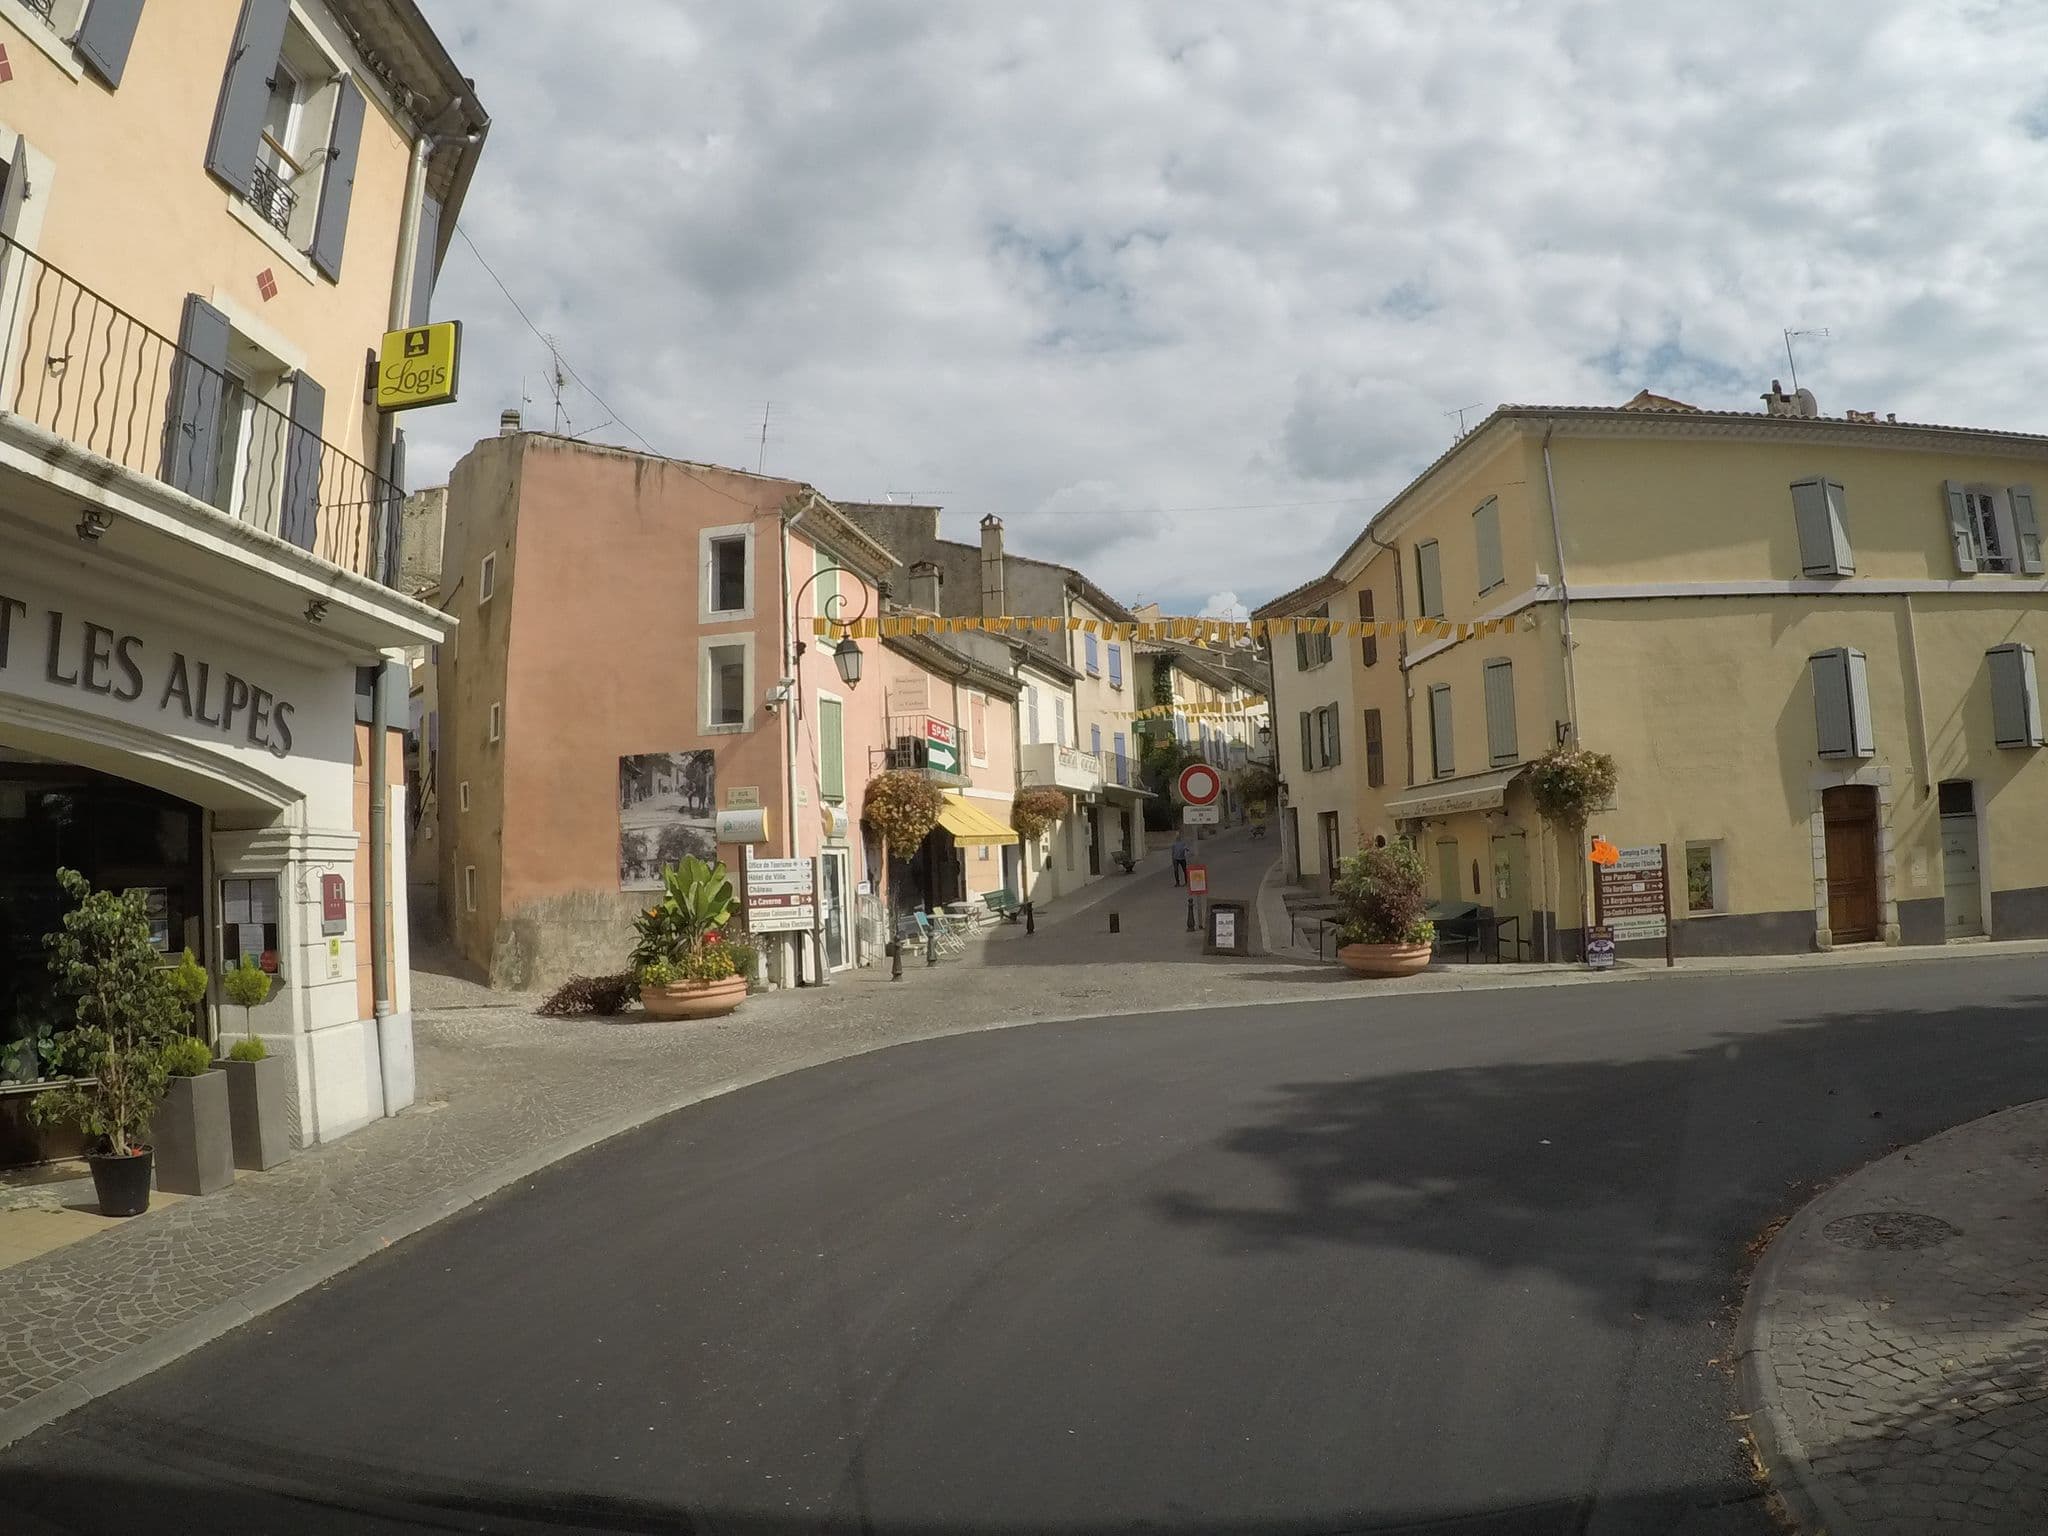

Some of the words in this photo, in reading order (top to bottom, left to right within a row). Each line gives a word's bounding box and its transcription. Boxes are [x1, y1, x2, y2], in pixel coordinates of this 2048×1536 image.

[381, 359, 446, 395] Logis
[46, 610, 144, 702] LES
[160, 651, 295, 759] ALPES
[748, 861, 763, 869] Office
[748, 873, 763, 881] Hôtel
[773, 872, 786, 880] Ville
[333, 883, 343, 899] H
[749, 885, 773, 893] Château
[758, 898, 782, 906] Caverne
